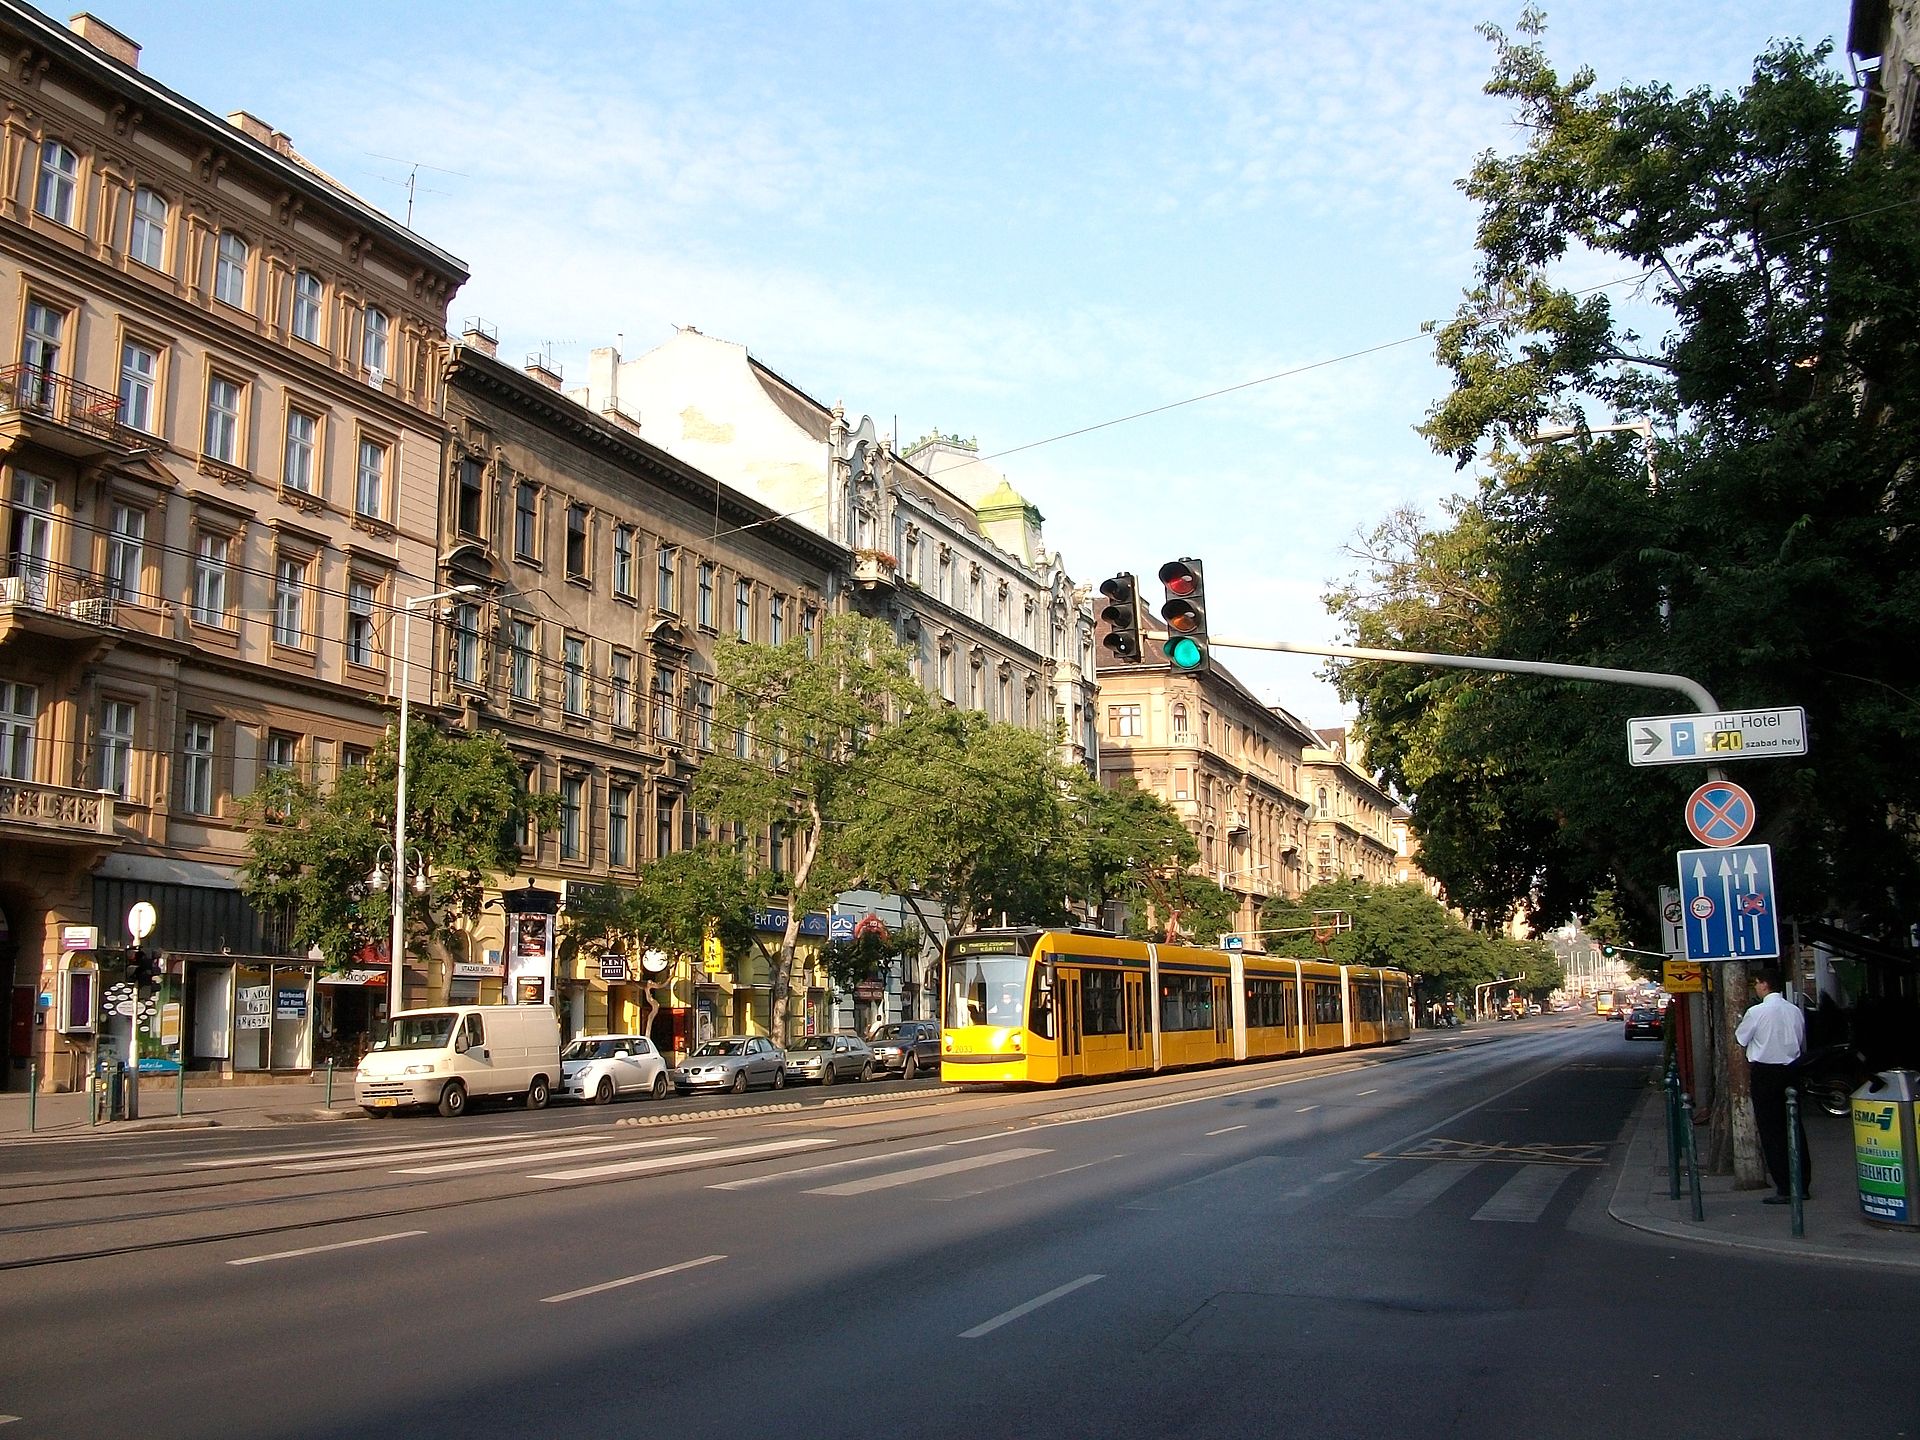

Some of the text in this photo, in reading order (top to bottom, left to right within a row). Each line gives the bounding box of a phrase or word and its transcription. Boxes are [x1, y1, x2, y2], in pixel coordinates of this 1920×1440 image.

[1714, 713, 1780, 730] nH Hotel
[1675, 730, 1689, 748] P
[1745, 738, 1801, 748] szabad hely
[774, 915, 806, 929] OPA
[959, 944, 967, 953] 6
[1854, 1109, 1876, 1123] ESMA
